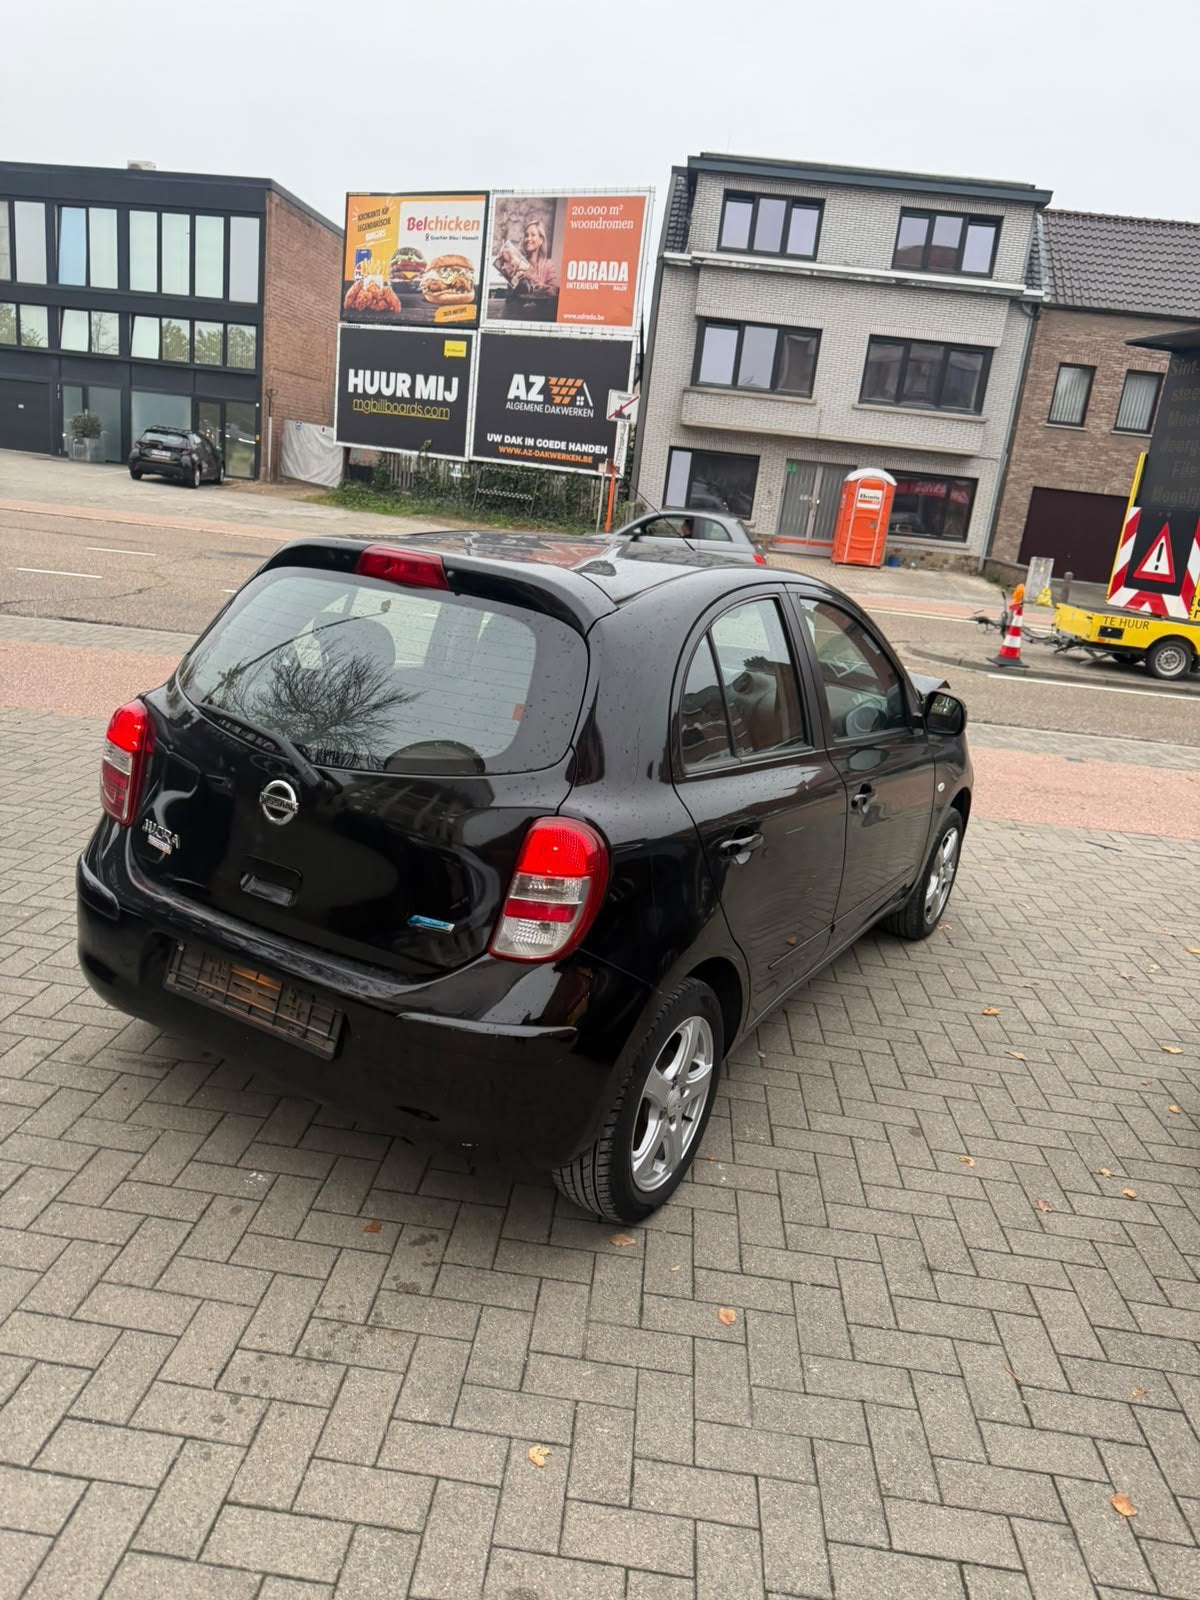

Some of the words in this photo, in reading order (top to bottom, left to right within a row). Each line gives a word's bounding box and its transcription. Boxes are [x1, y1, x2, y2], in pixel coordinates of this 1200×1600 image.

[571, 205, 607, 216] 20.000
[407, 215, 481, 232] Belchicken
[570, 217, 634, 230] woondromen
[566, 260, 629, 282] ODRADA
[566, 282, 599, 290] INTERIEUR
[563, 313, 604, 321] www.odrada.be
[347, 368, 412, 398] HUUR
[415, 373, 459, 403] MIJ
[506, 373, 546, 402] AZ
[352, 398, 451, 419] mgbillboards.com
[505, 401, 544, 414] ALGEMENE
[544, 404, 594, 418] DAKWERKEN
[486, 433, 503, 443] UW
[504, 435, 524, 445] DAK
[524, 437, 535, 446] IN
[536, 438, 567, 450] GOEDE
[568, 442, 608, 455] HANDEN
[498, 446, 594, 464] WWW.AZ-DAKWERKEN.BE
[1103, 615, 1115, 626] TE
[1119, 618, 1150, 630] HUUR
